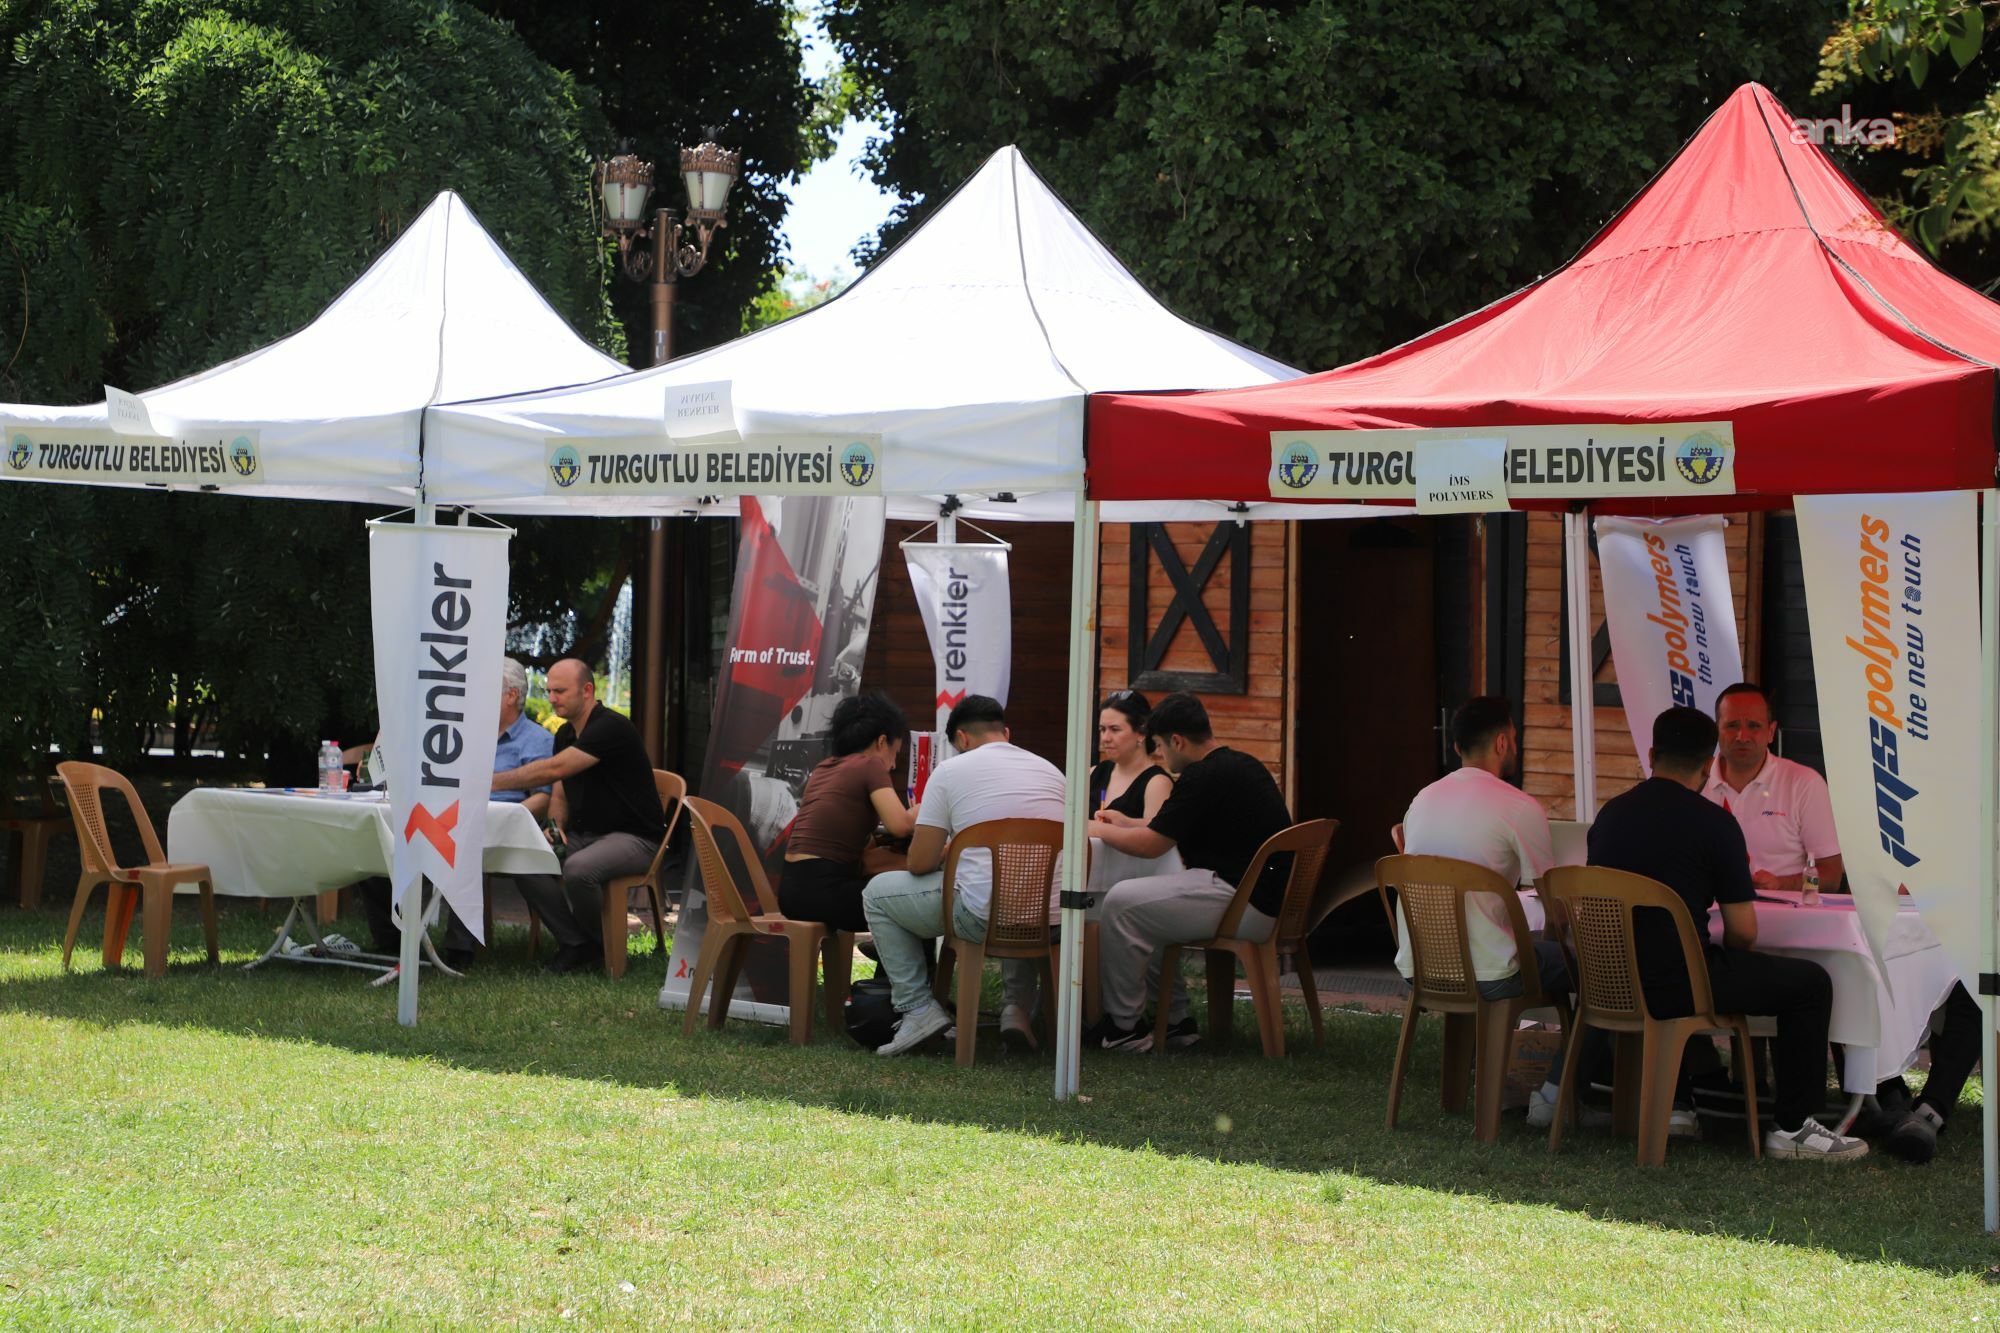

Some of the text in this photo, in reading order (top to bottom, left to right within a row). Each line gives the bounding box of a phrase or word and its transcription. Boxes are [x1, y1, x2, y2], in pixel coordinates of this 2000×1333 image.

[38, 440, 227, 473] TURGUTLU BELEDİYESİ
[588, 445, 833, 484] TURGUTLU BELEDİYESİ
[1329, 451, 1416, 485] TURGU
[1429, 490, 1494, 502] POLYMERS
[1449, 473, 1470, 486] İMS
[941, 567, 969, 682] renkler
[1691, 602, 1707, 648] new
[759, 647, 774, 664] of
[776, 647, 814, 666] Trust.
[1698, 651, 1713, 685] the
[1906, 623, 1926, 689] new
[418, 561, 472, 789] renkler
[1906, 692, 1929, 741] the
